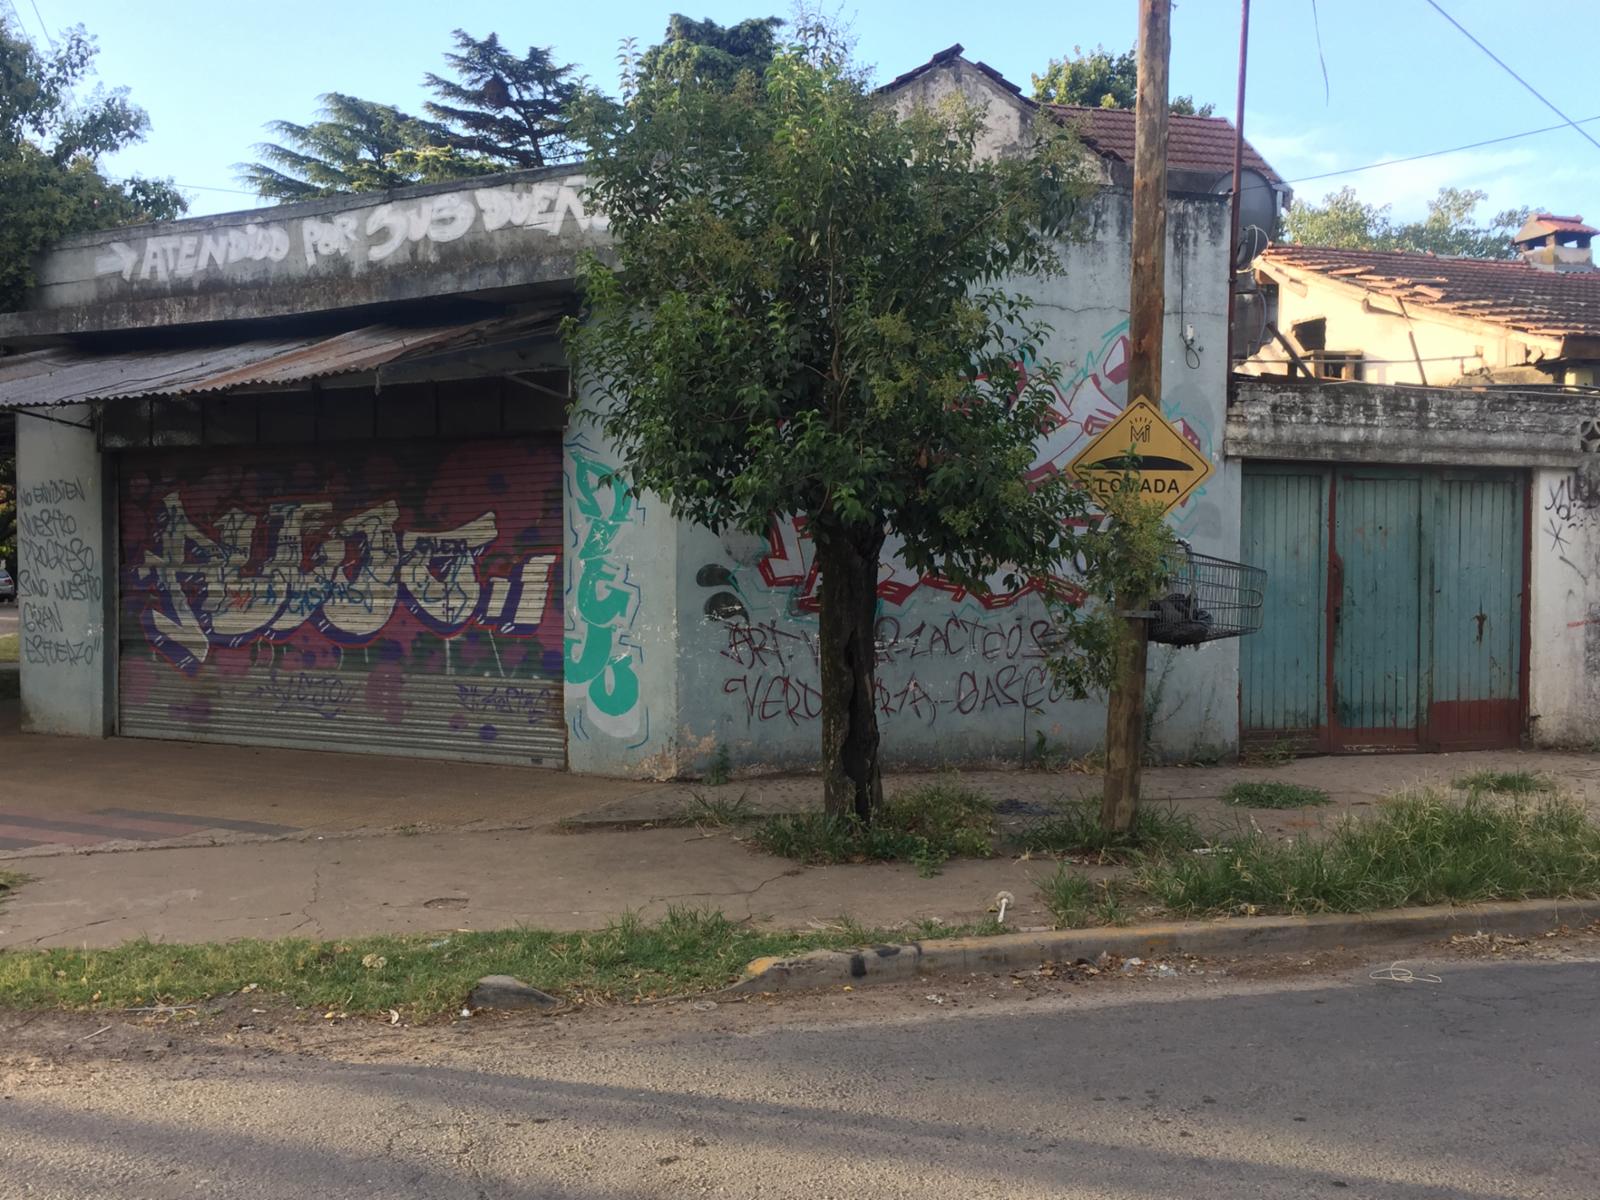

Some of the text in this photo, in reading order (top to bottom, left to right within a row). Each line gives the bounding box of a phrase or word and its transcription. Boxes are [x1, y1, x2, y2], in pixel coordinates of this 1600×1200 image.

[302, 213, 360, 268] POR
[366, 190, 477, 262] SUS
[1097, 477, 1181, 495] LOADA
